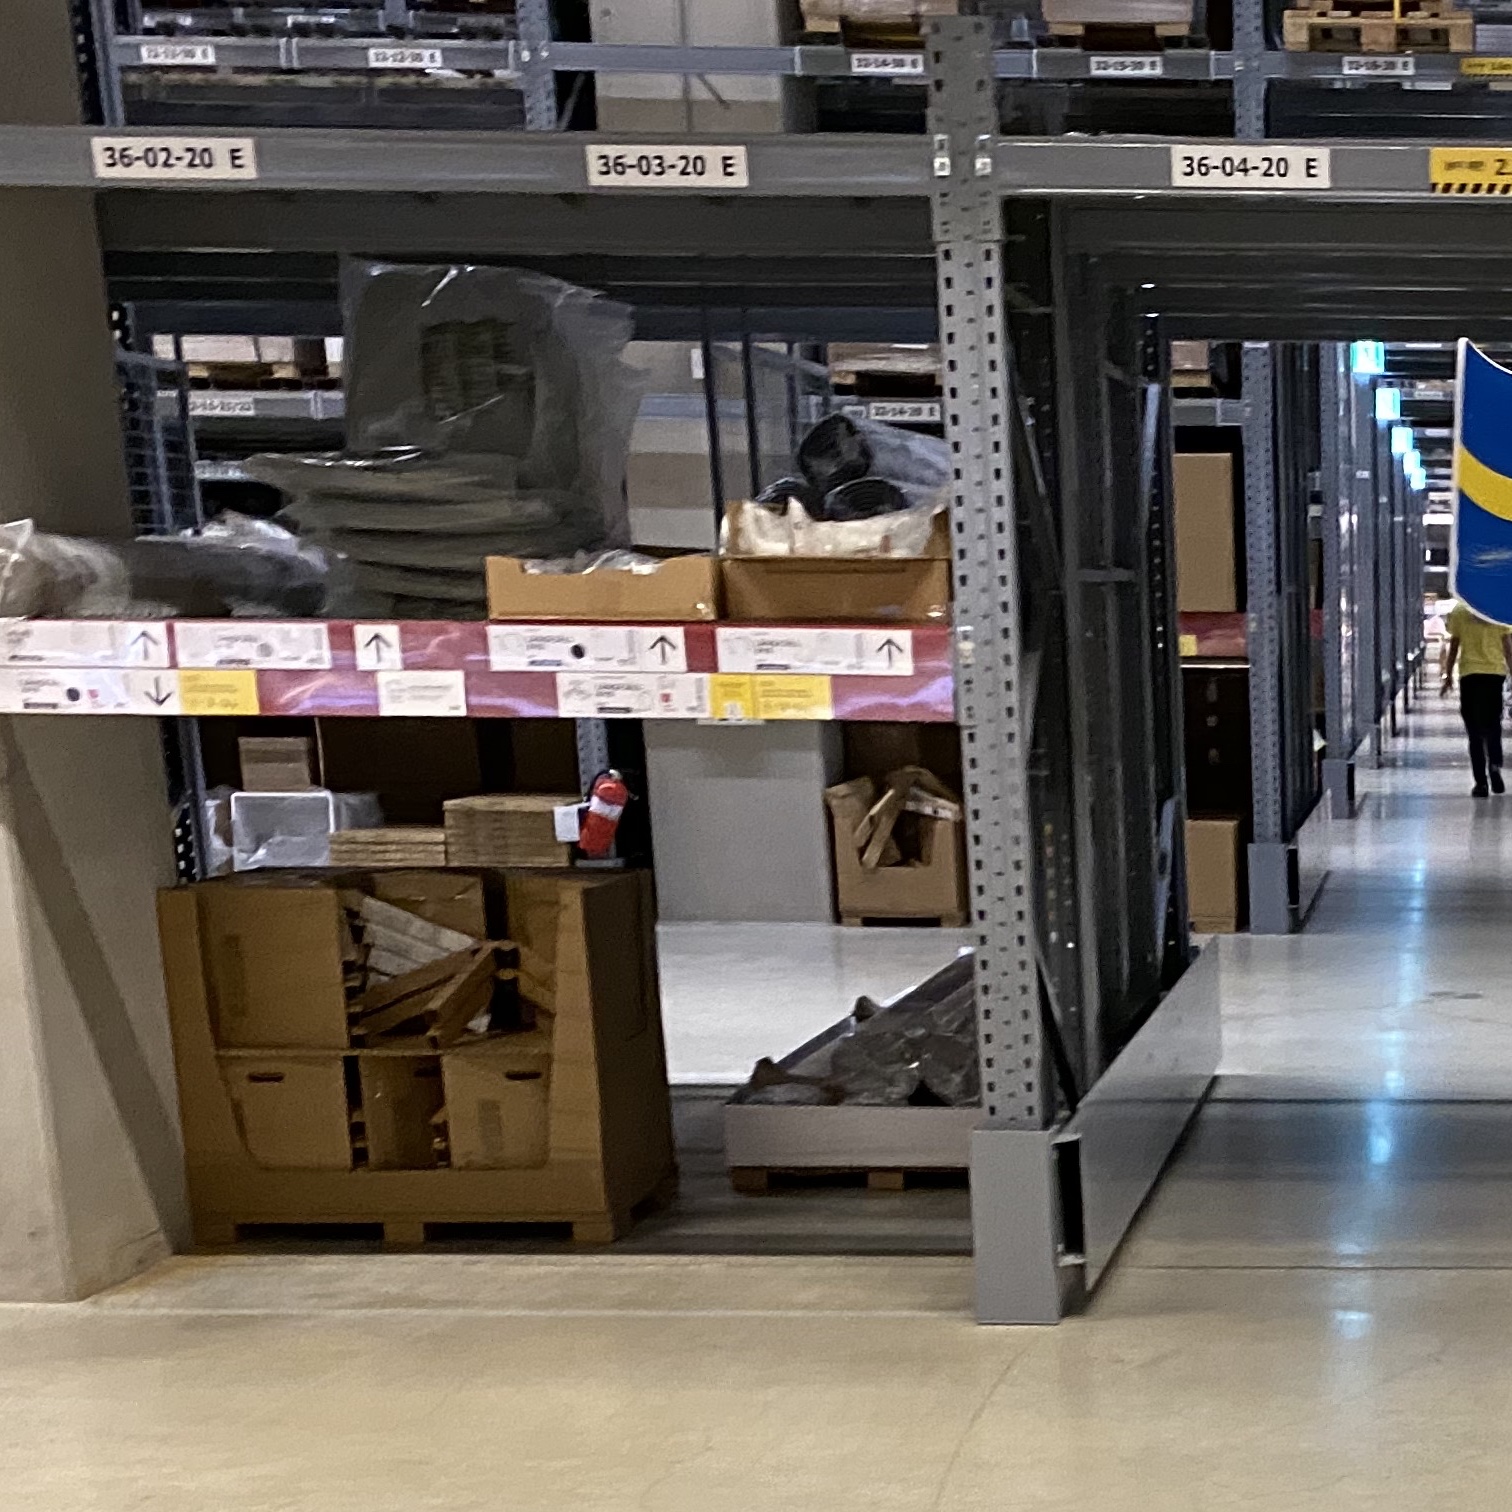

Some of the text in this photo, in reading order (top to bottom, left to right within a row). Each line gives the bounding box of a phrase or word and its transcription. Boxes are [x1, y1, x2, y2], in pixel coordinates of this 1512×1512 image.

[103, 147, 245, 168] 36-02-20 E
[597, 154, 736, 177] 36-03-20 E
[1182, 156, 1318, 178] 36-04-20 E
